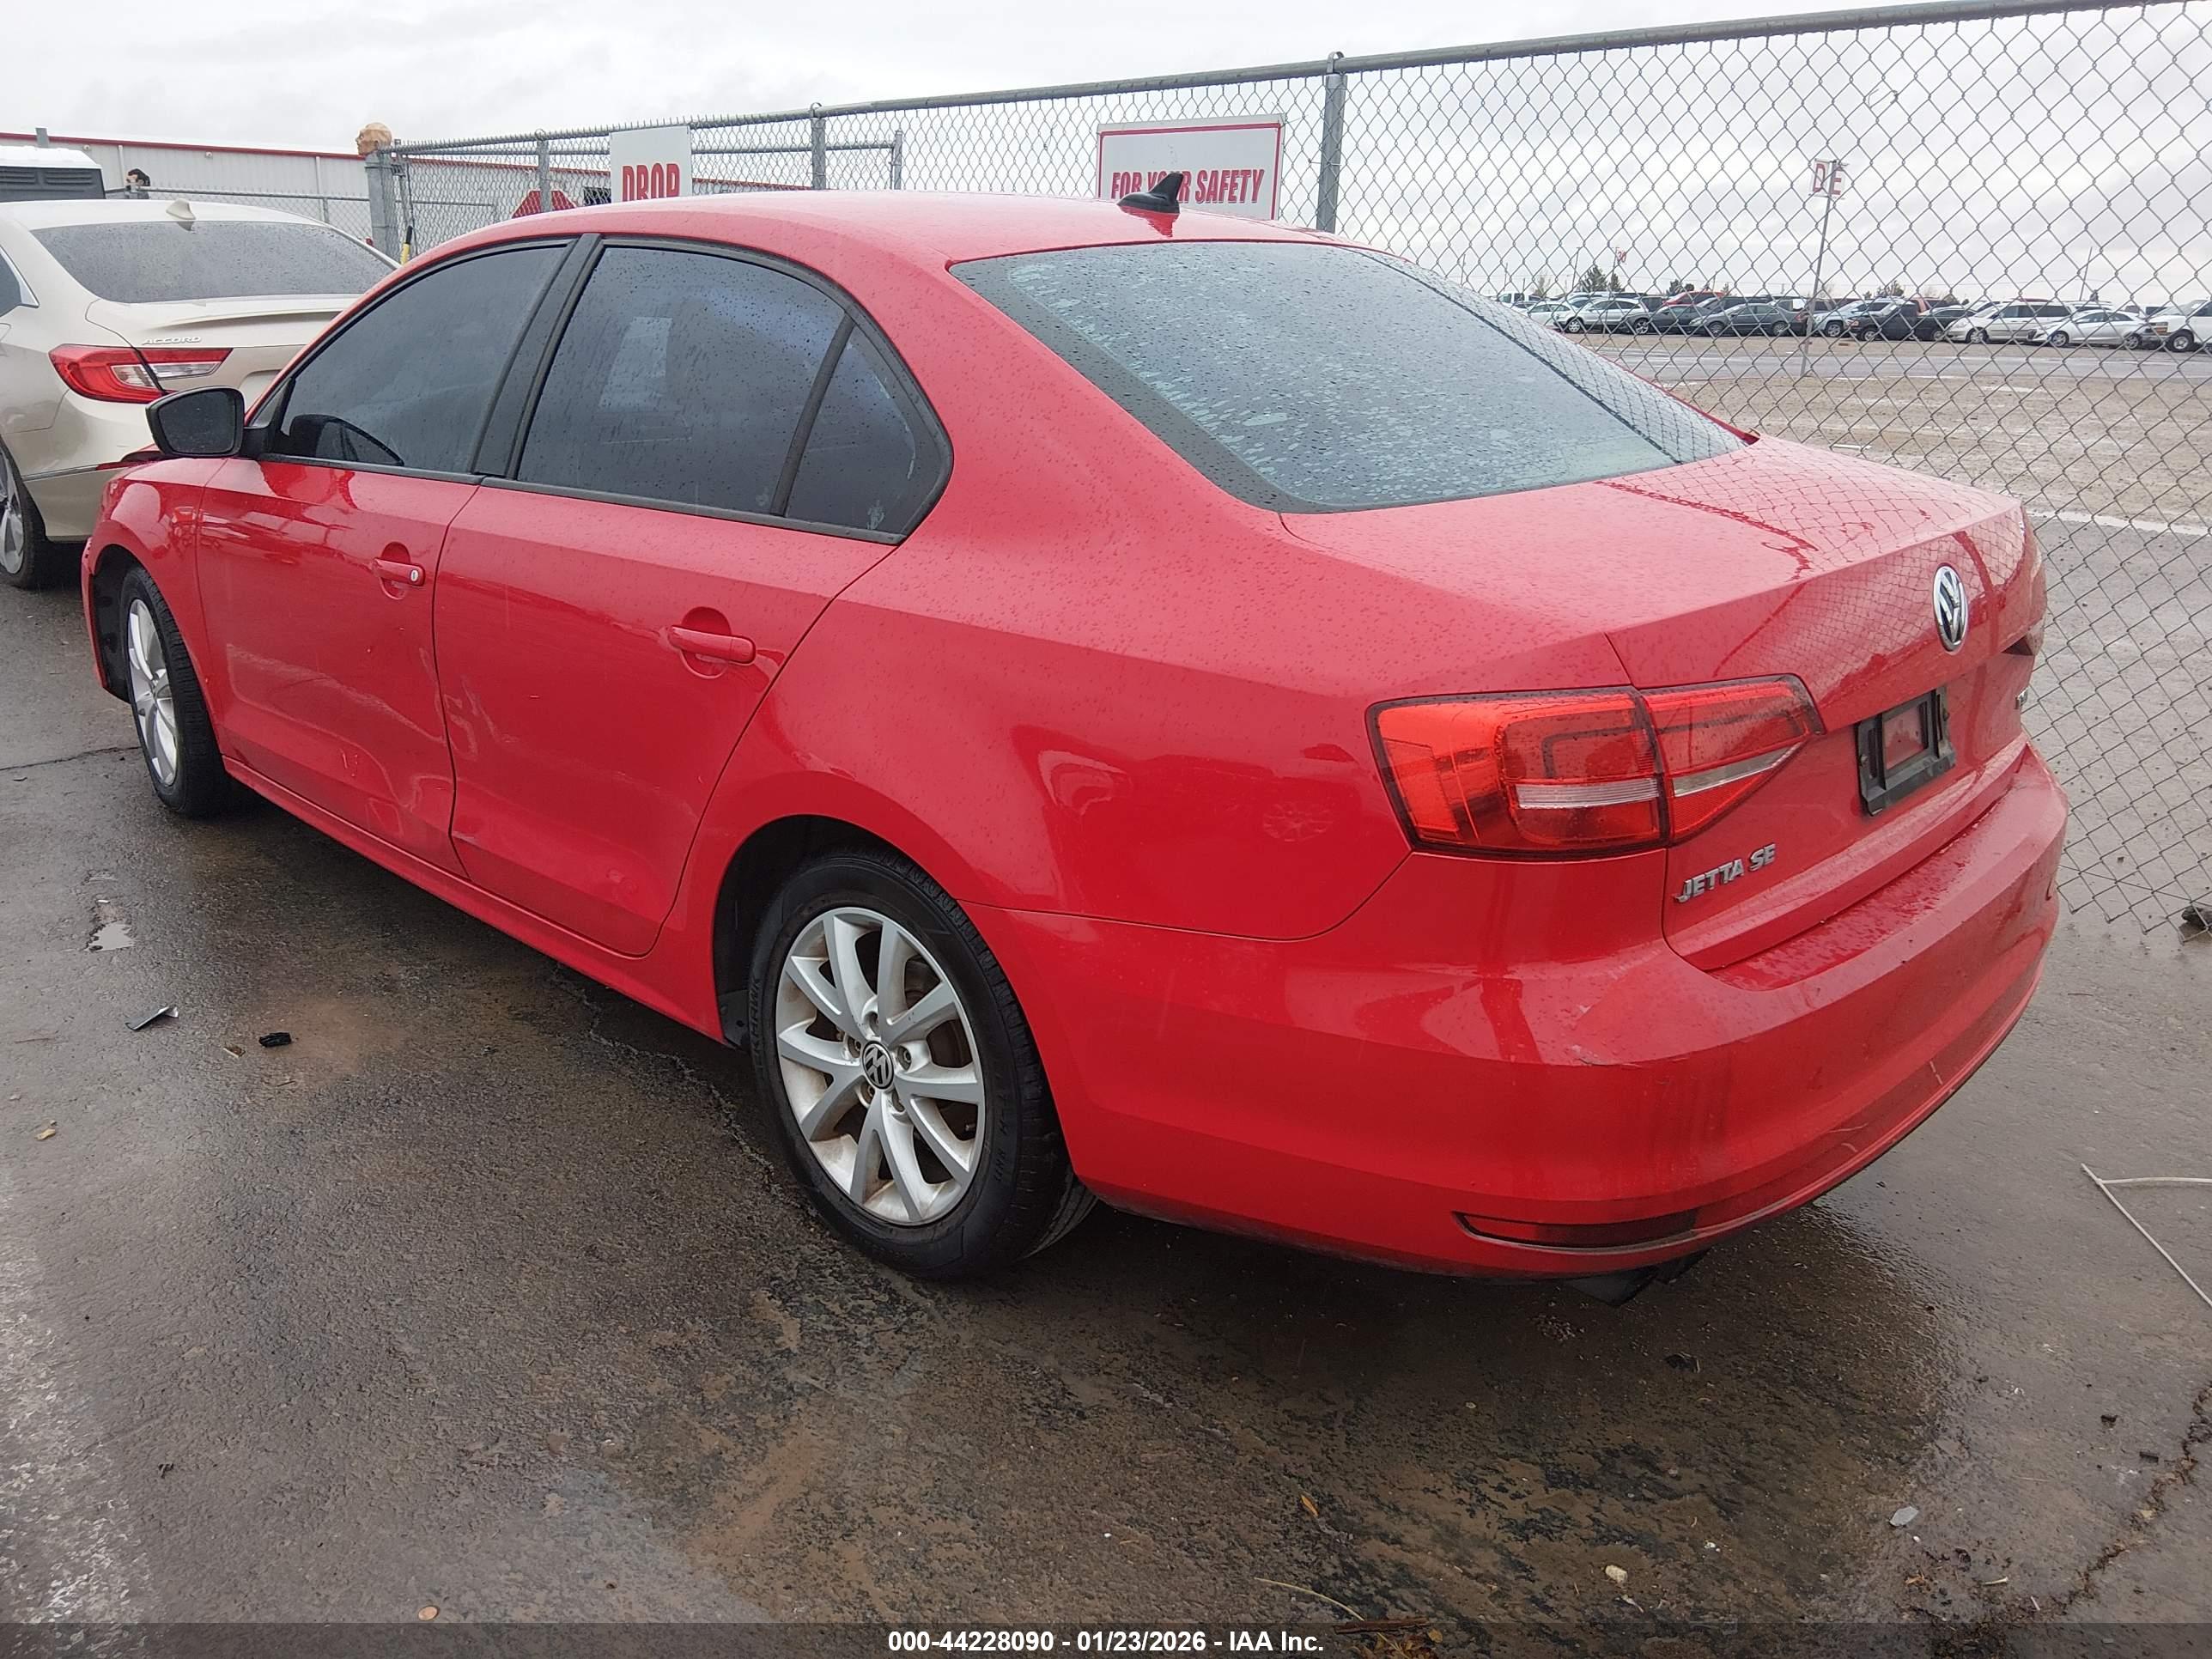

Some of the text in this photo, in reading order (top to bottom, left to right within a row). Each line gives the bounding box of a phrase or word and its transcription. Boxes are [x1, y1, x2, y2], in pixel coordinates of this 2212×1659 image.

[1111, 172, 1143, 199] FOR
[1194, 169, 1265, 204] SAFETY
[142, 336, 201, 345] ACCORD
[1674, 842, 1776, 902] JETTA SE
